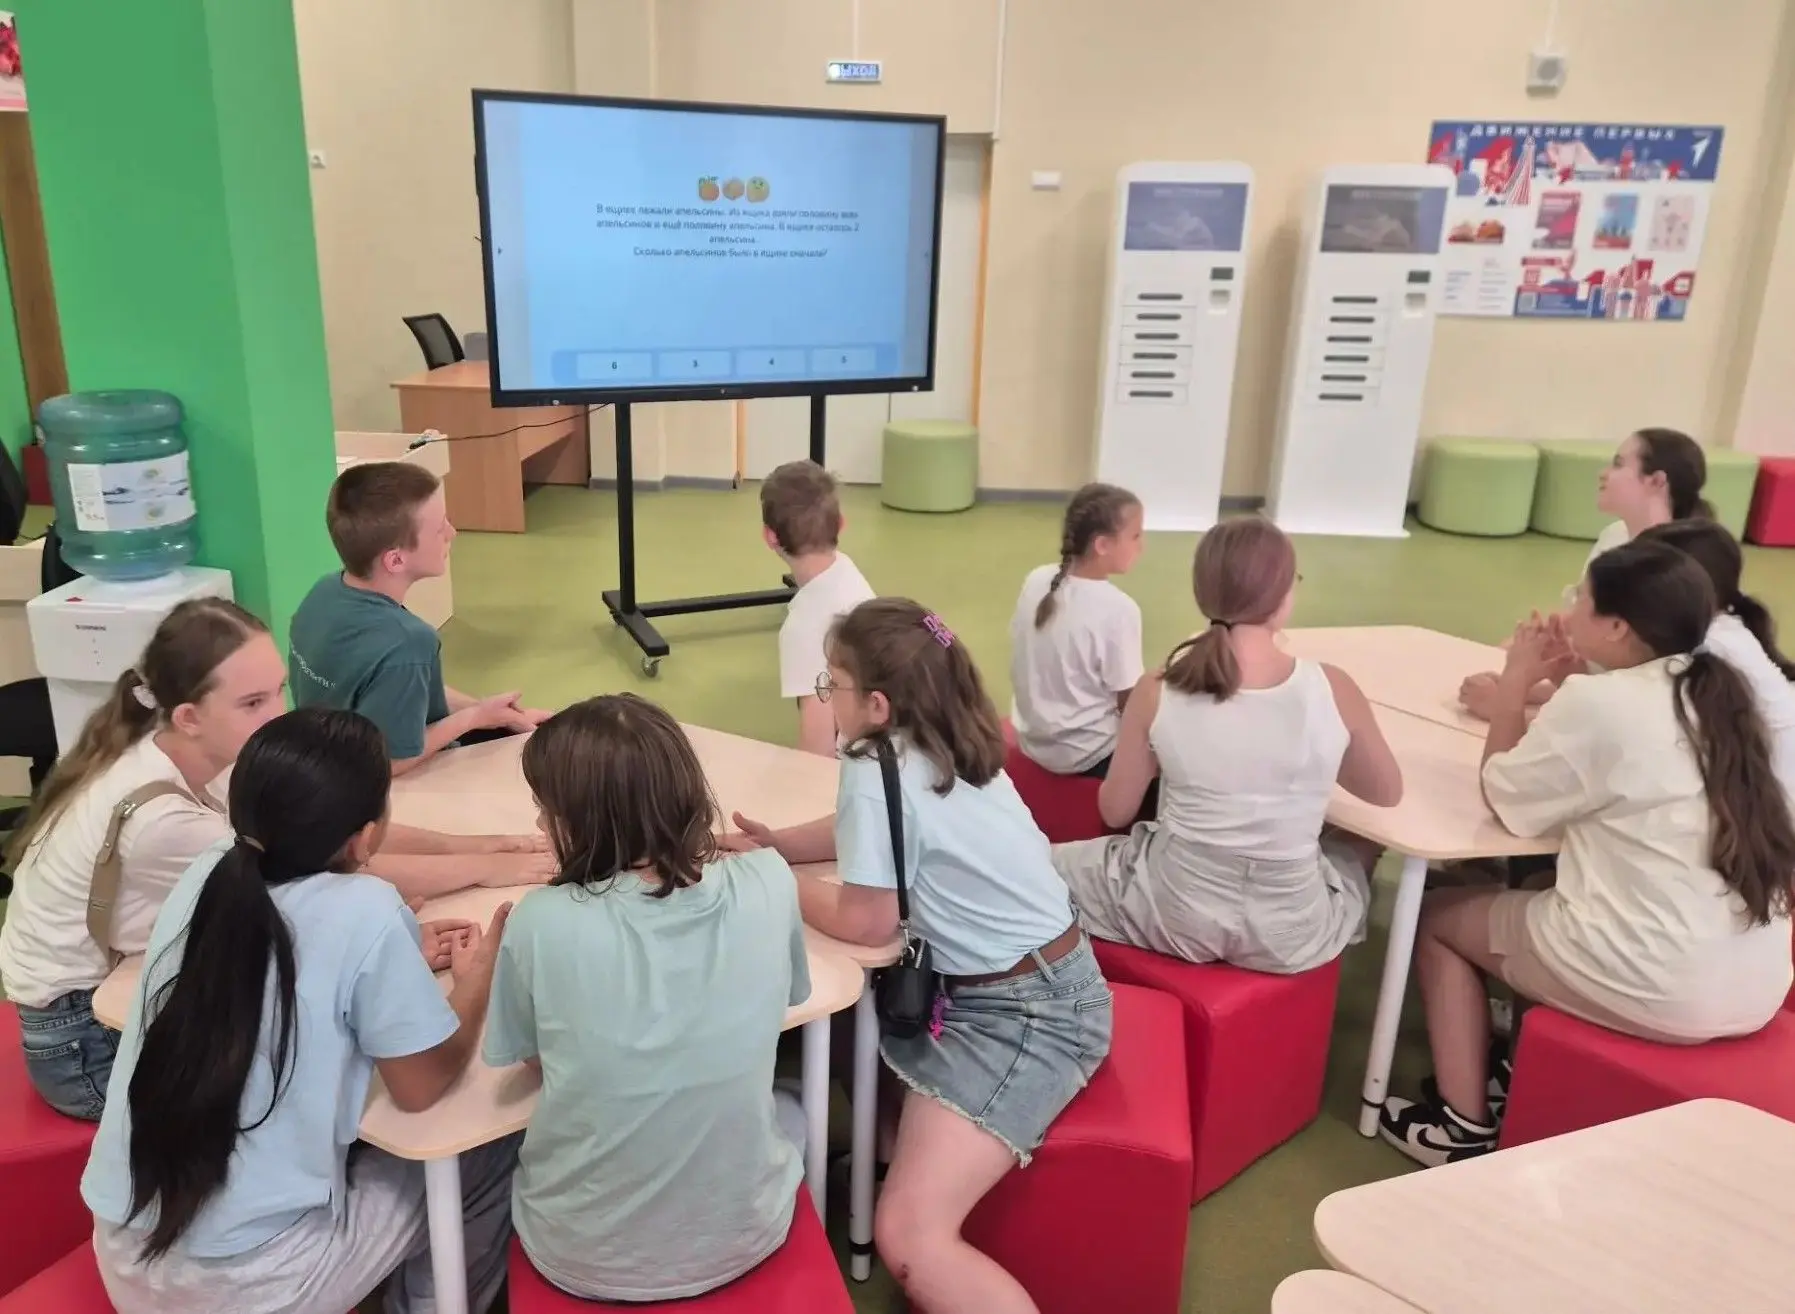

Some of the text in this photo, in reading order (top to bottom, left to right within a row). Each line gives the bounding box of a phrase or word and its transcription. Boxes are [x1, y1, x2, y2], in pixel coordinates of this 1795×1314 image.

[832, 63, 877, 77] ЫХОД
[1470, 124, 1584, 137] ДВИЖЕНИЕ
[611, 361, 618, 370] 6
